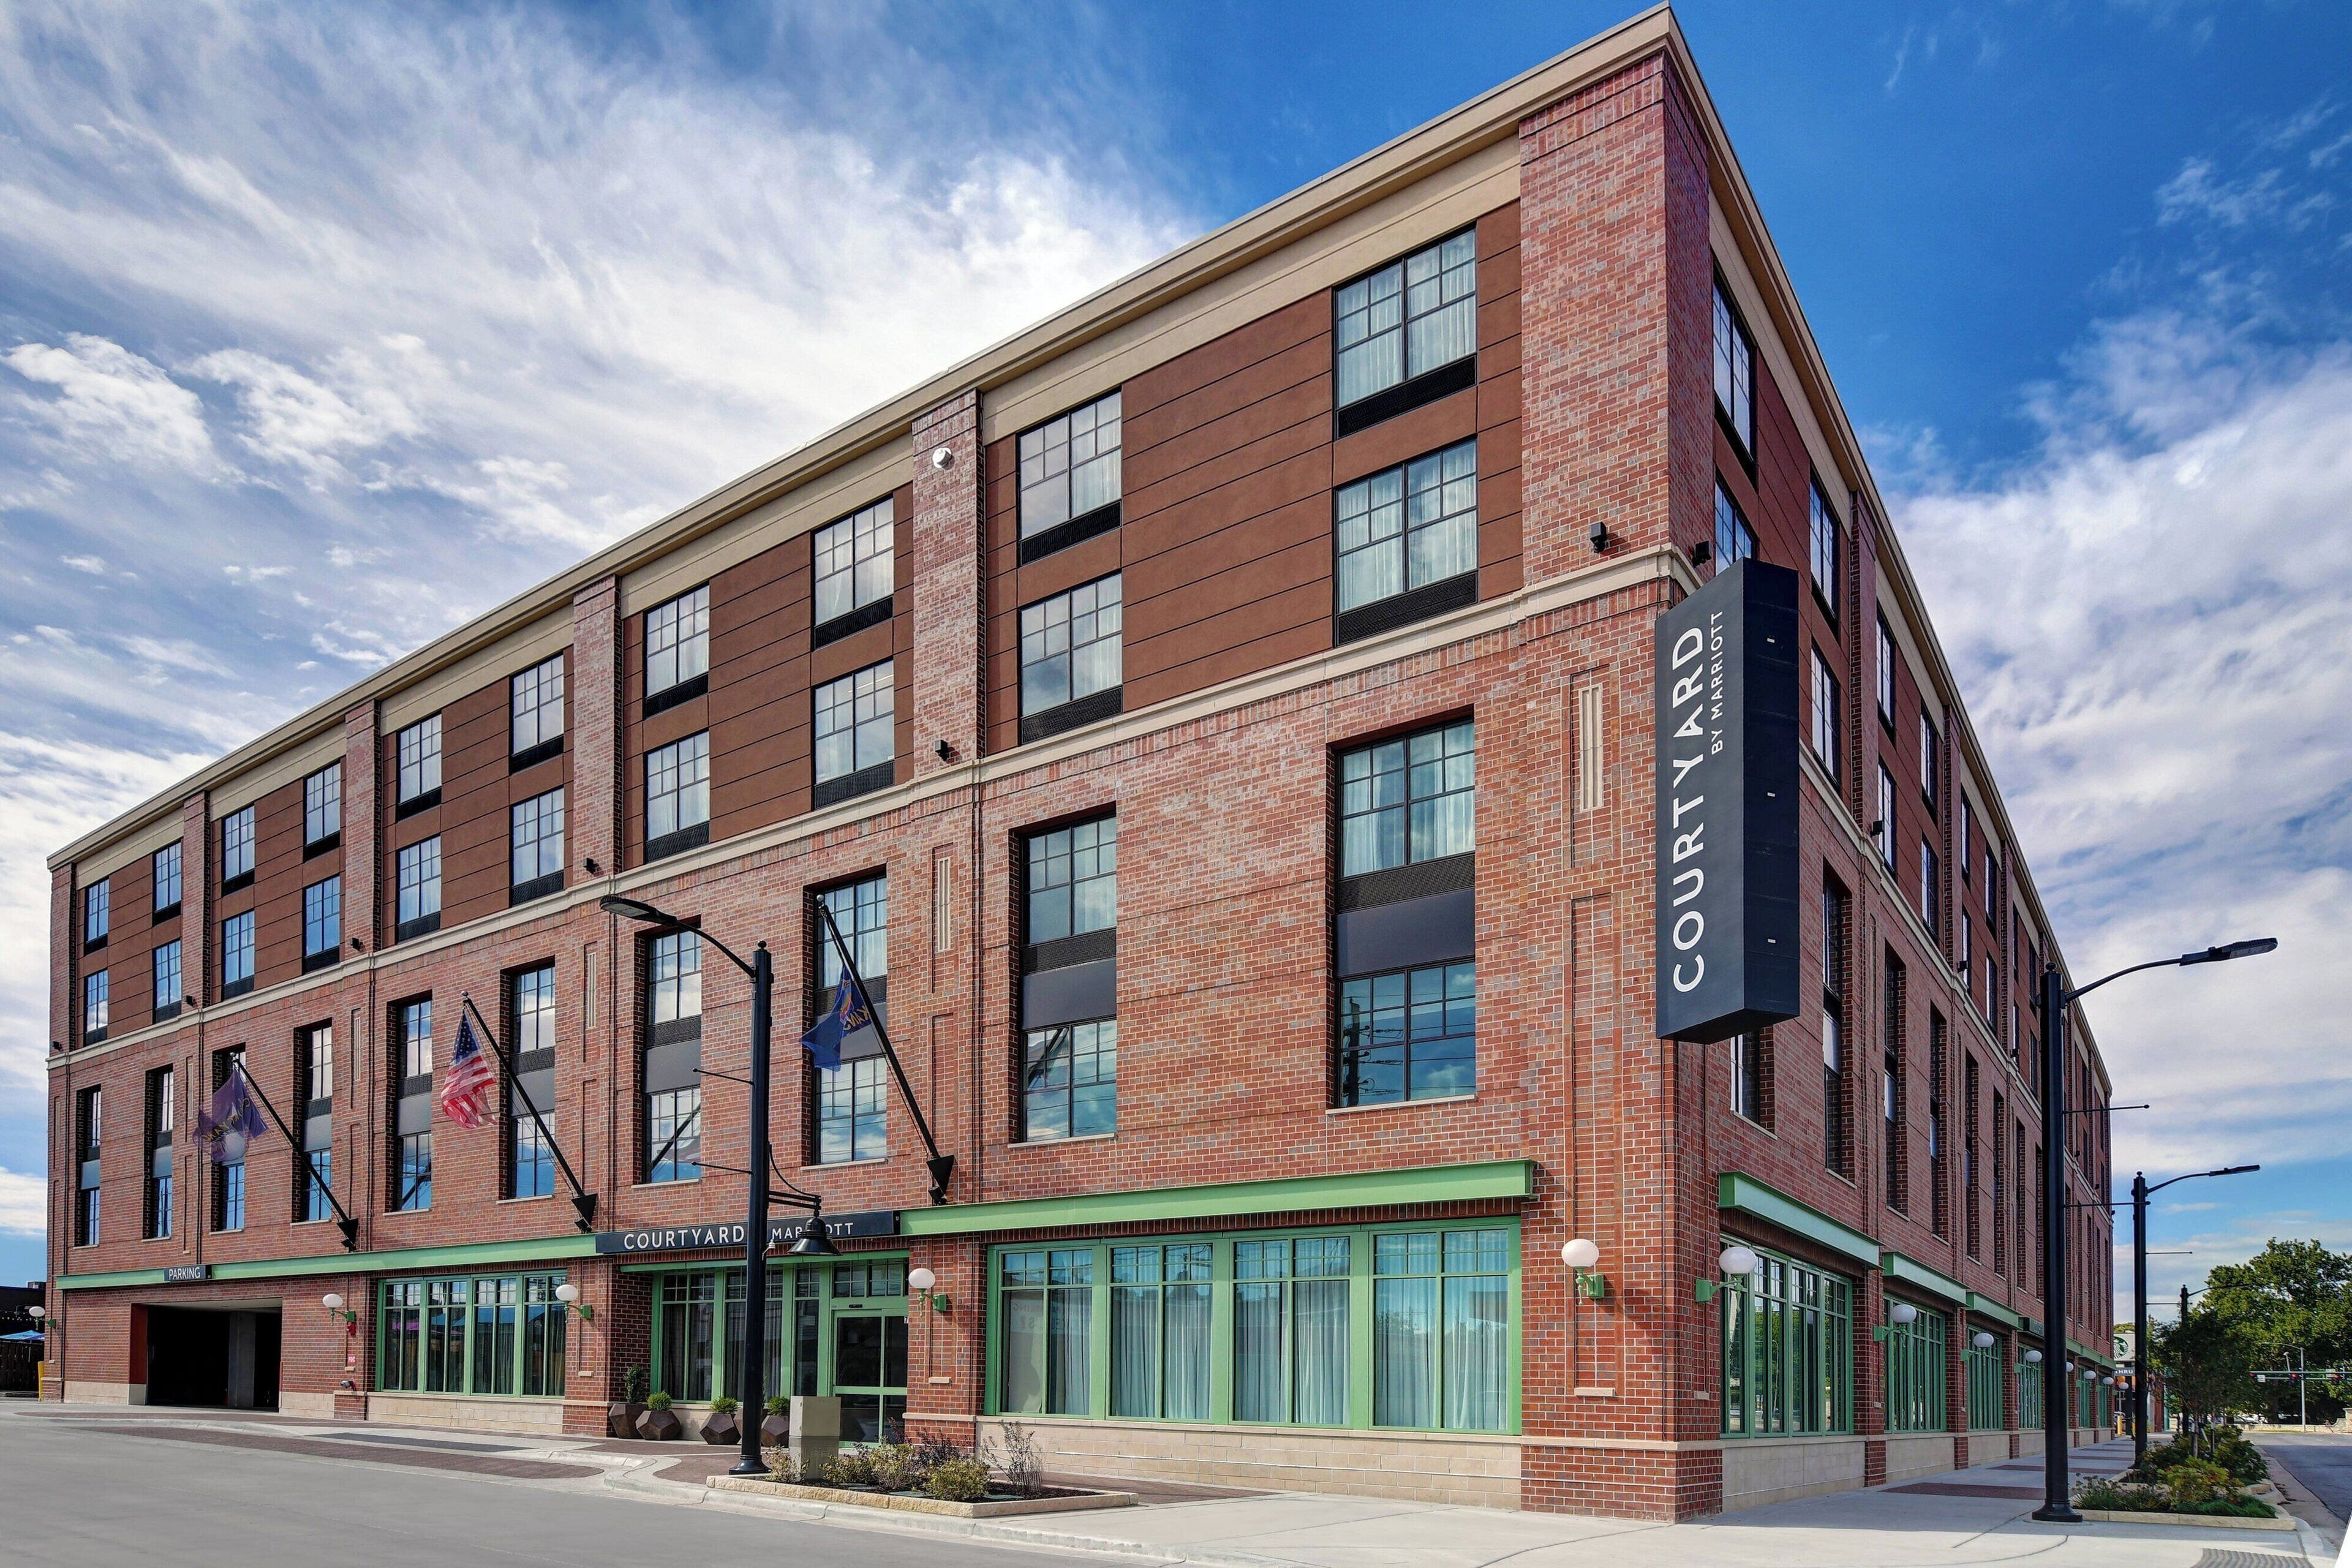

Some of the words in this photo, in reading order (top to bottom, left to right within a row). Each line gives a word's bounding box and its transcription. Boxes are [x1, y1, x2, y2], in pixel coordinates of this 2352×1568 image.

[1711, 611, 1723, 721] MARRIOTT
[1711, 729, 1724, 755] BY
[1672, 627, 1705, 993] COURTYARD
[624, 1226, 745, 1250] COURTYARD
[772, 1223, 854, 1240] MAROTT
[168, 1267, 201, 1280] PARKING
